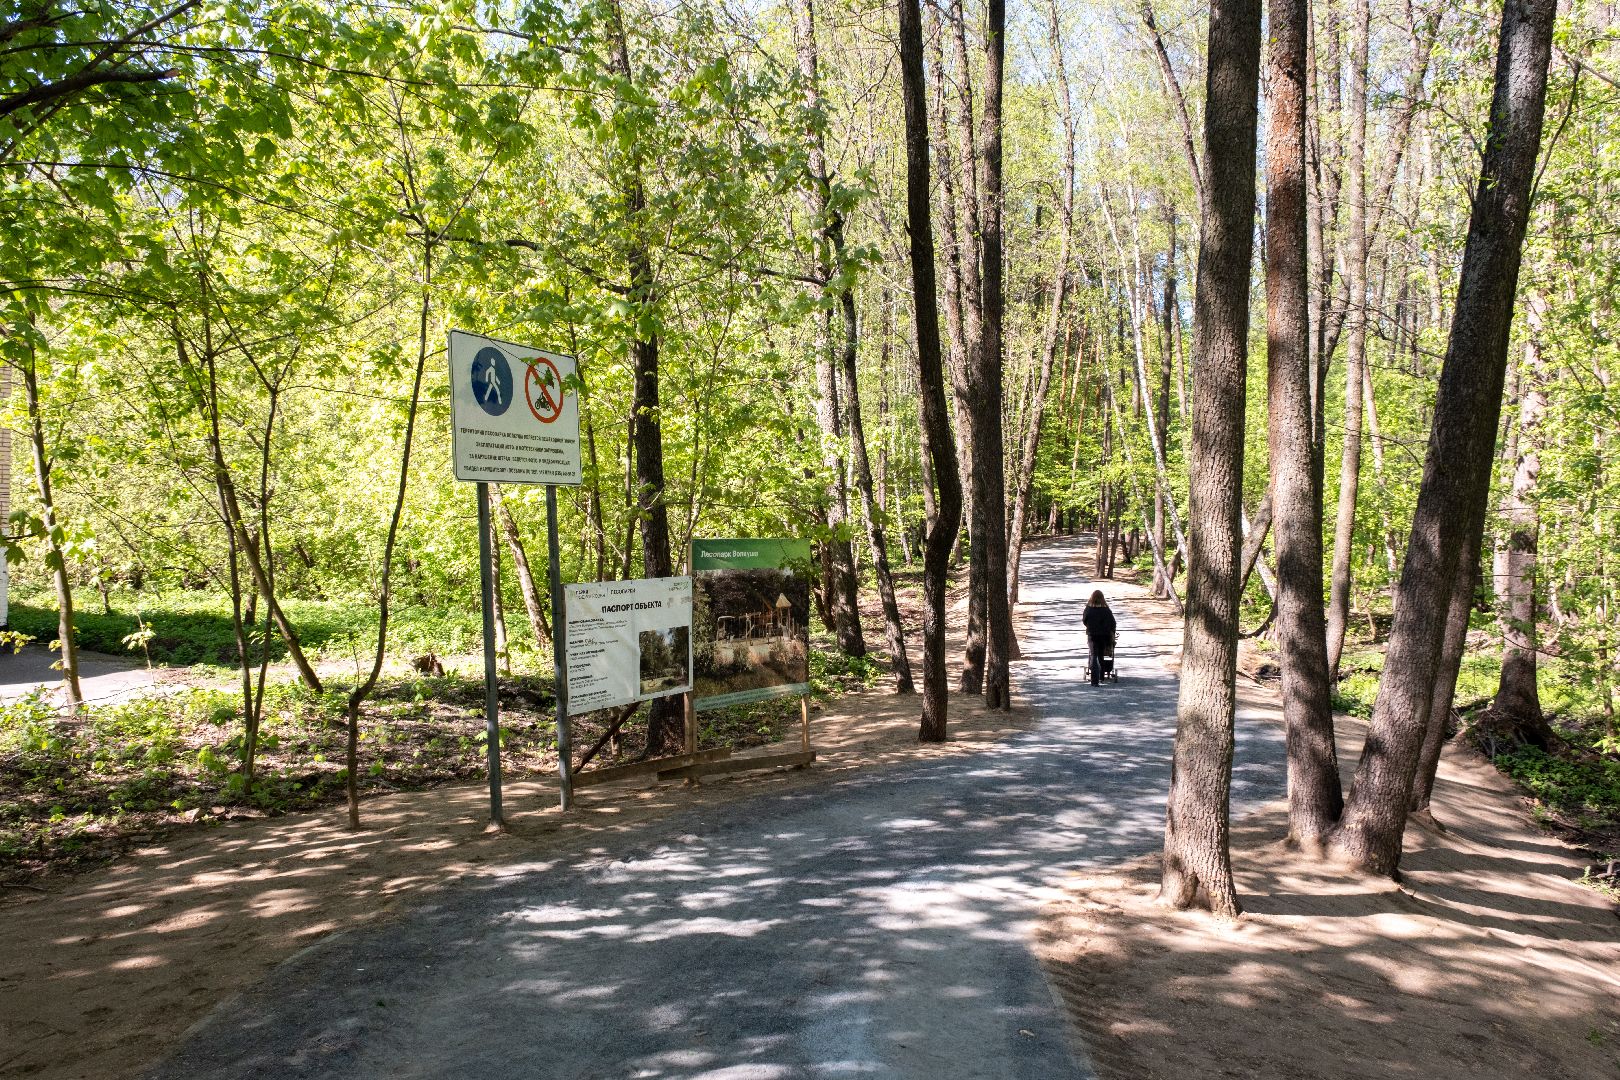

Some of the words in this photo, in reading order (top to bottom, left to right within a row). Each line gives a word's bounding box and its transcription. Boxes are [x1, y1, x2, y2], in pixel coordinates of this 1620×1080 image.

[701, 550, 731, 558] Лесопарк
[602, 603, 633, 613] ПАСПОРТ
[634, 600, 662, 610] ОБЪЕКТА
